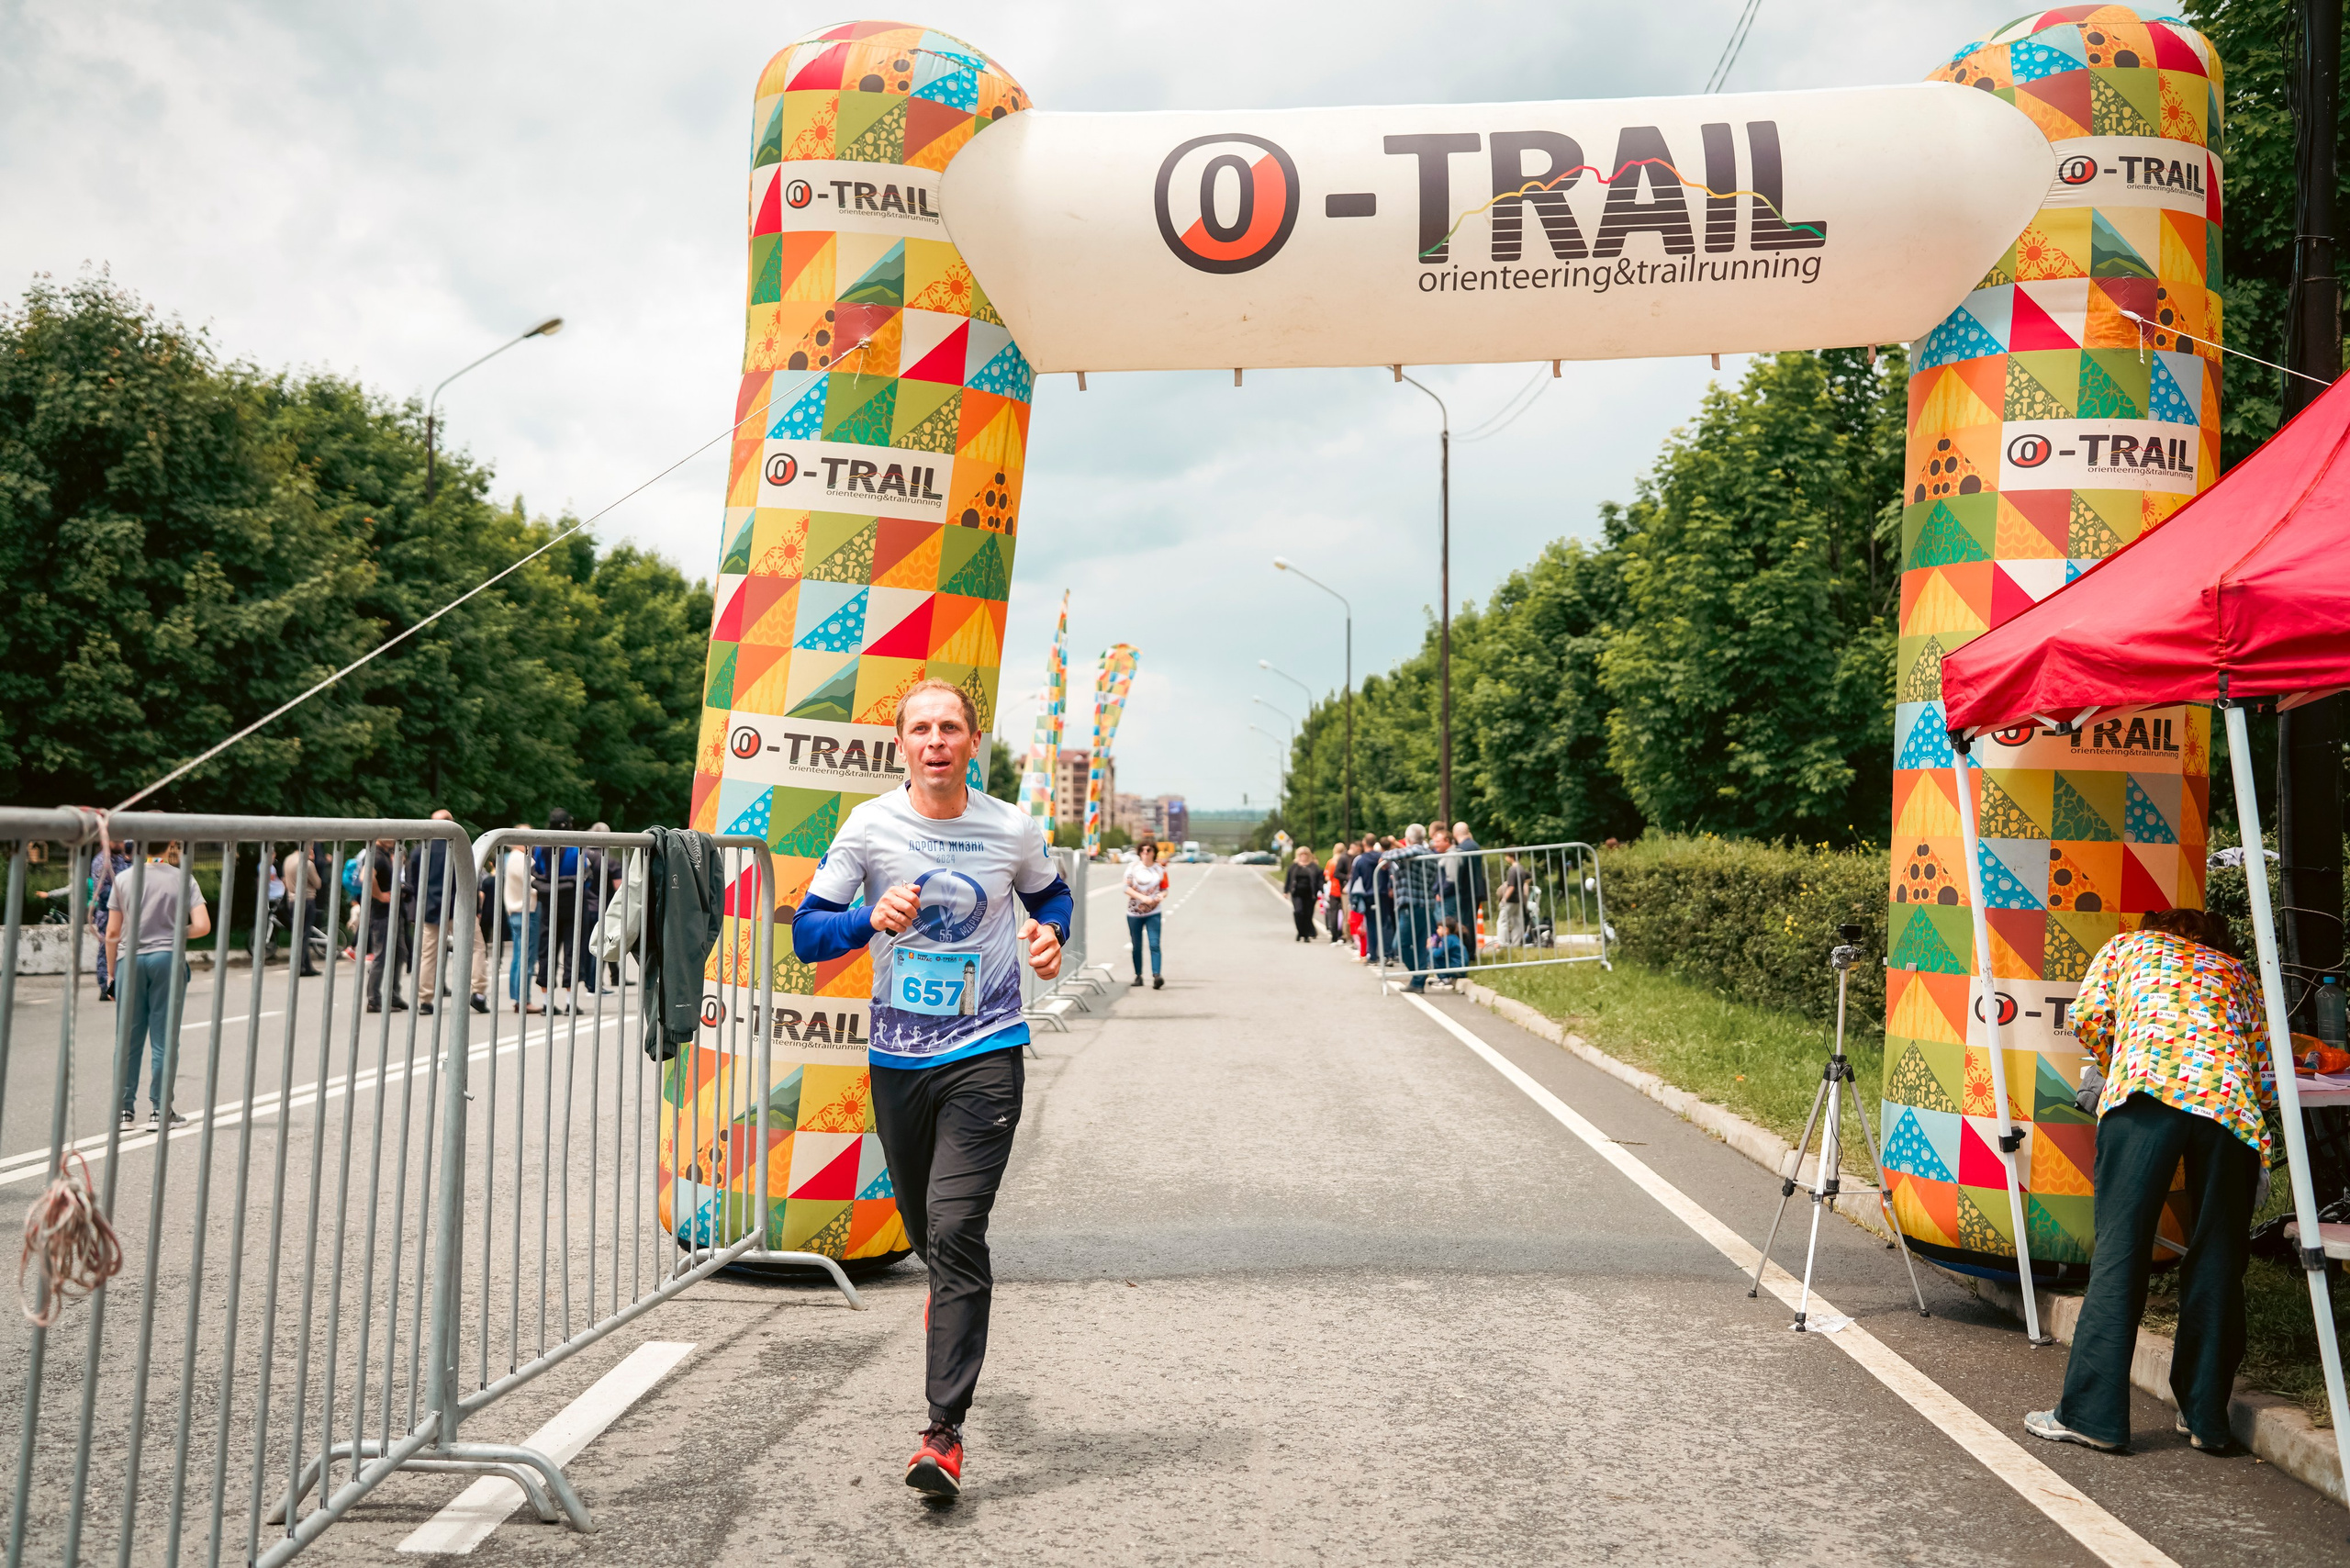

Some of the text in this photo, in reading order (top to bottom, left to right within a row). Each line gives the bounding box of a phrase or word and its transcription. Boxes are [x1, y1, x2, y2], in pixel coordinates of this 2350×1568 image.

[838, 207, 939, 225] orienteering&trailrunning
[1417, 253, 1822, 293] orienteering&trailrunning
[2087, 465, 2193, 481] orienteering&trailrunning
[826, 488, 942, 508] orienteering&trailrunning
[2070, 746, 2179, 760] orienteering&trailrunning
[789, 764, 904, 781] orienteering&trailrunning
[908, 839, 984, 852] ДОРОГА ЖИЗНИ
[936, 854, 956, 864] 2024
[959, 901, 987, 936] МАРАФОН
[901, 976, 965, 1007] 657
[753, 1036, 867, 1052] onteering&trailrunning
